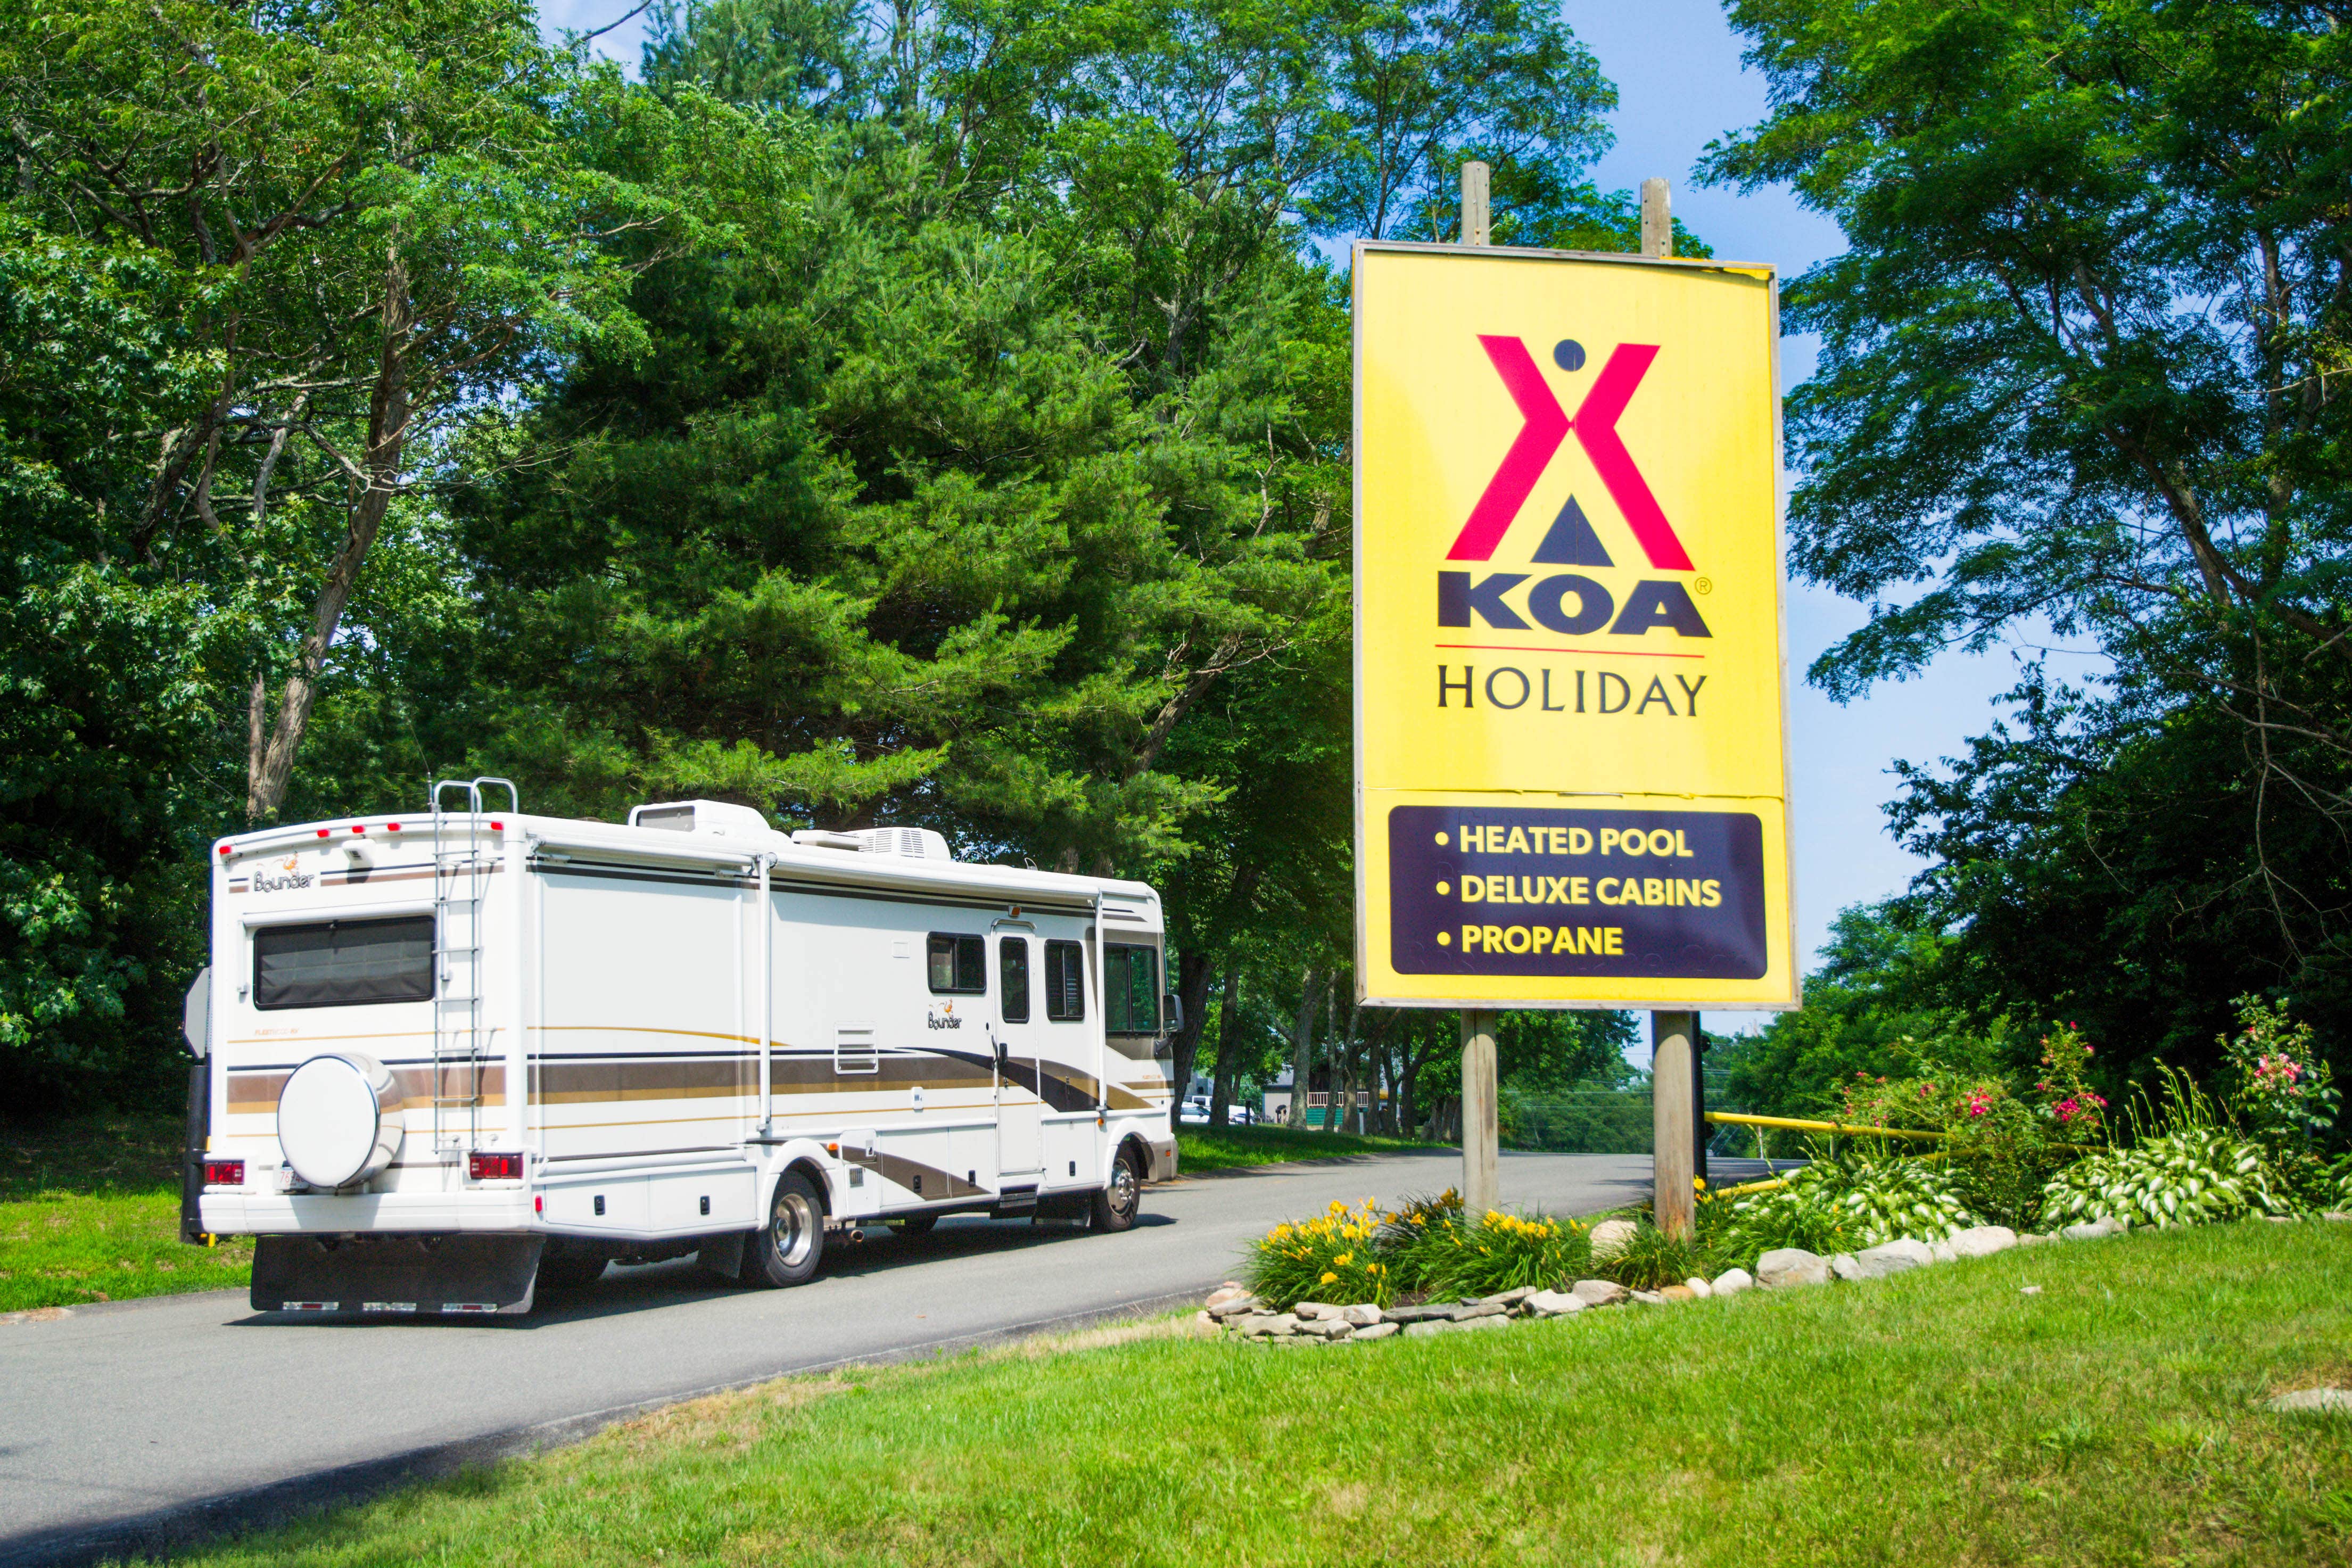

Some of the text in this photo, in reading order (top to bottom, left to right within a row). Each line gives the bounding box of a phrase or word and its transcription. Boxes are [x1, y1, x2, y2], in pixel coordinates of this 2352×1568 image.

[1438, 570, 1713, 639] KOA
[1438, 664, 1707, 717] HOLIDAY
[1460, 825, 1694, 857] HEATED POOL
[254, 871, 315, 893] Bounder
[1461, 875, 1722, 907] DELUXE CABINS
[1462, 925, 1623, 955] PROPANE
[928, 1011, 962, 1030] Bounder
